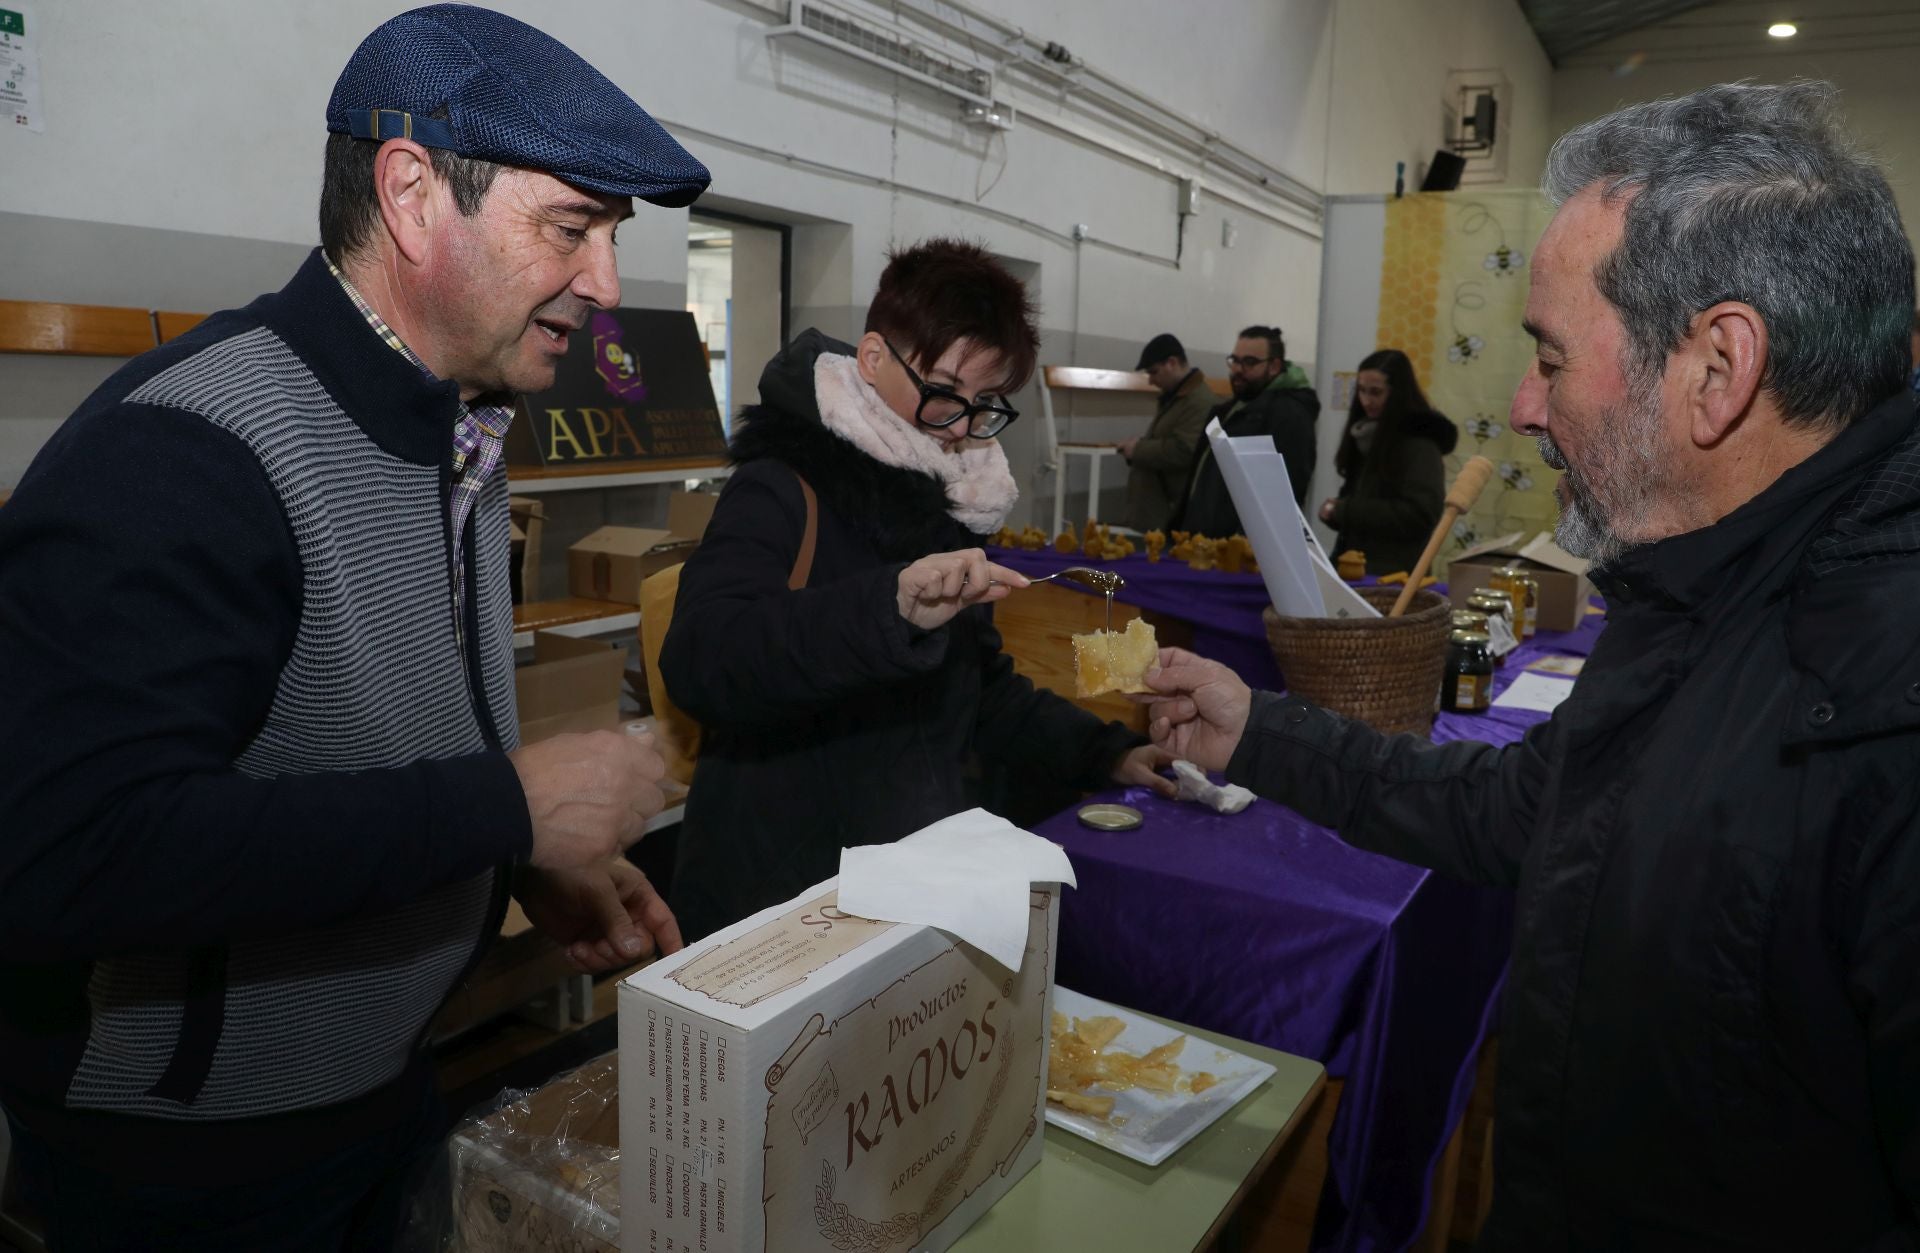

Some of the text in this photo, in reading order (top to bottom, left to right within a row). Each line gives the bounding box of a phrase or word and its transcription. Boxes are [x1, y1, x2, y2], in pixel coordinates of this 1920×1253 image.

[545, 408, 648, 460] APA
[888, 978, 967, 1053] Productos
[665, 1055, 672, 1064] DE
[682, 1034, 690, 1068] PASTAS
[682, 1069, 690, 1082] DE
[682, 1083, 690, 1107] YEMA
[844, 1001, 997, 1171] RAMOS
[890, 1130, 957, 1196] ARTESANOS
